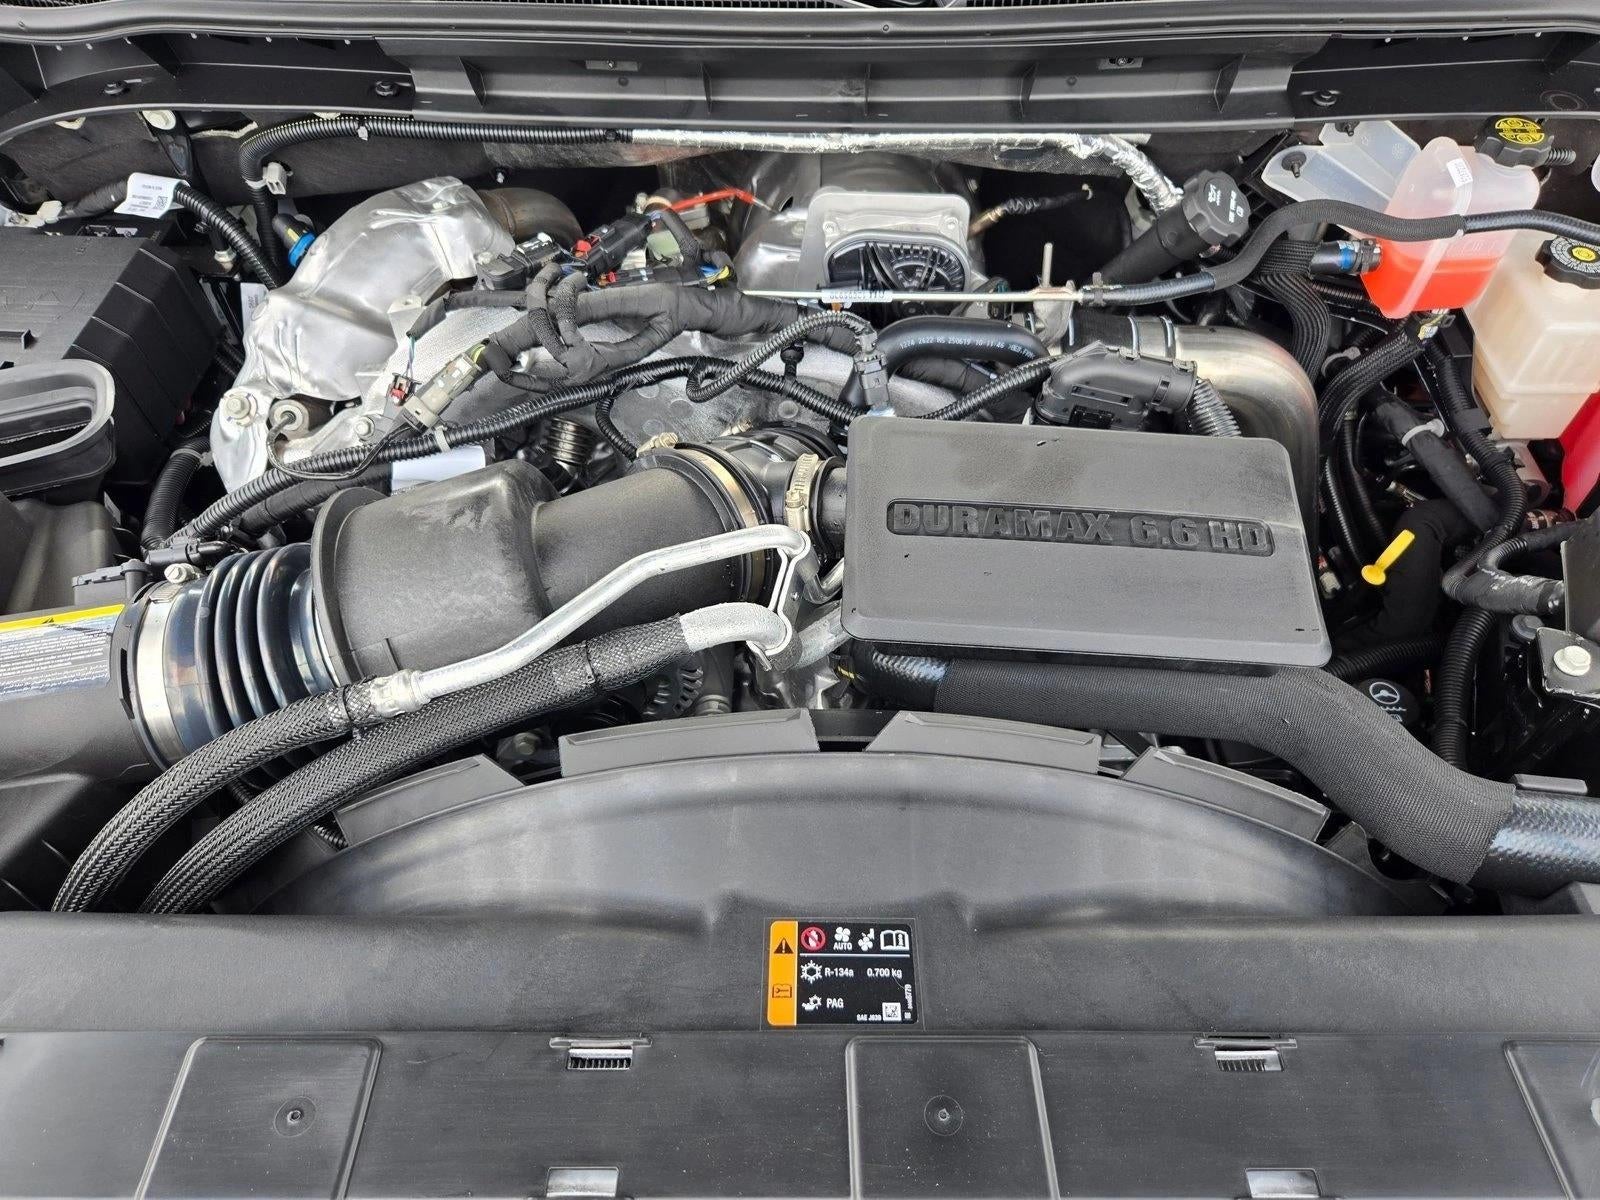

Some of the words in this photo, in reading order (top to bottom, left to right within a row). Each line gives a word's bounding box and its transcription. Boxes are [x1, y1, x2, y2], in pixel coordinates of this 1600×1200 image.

[893, 502, 1113, 542] DURAMAX
[1129, 514, 1199, 546] 6.6
[1207, 519, 1269, 552] HD
[833, 942, 852, 950] AUTO
[824, 967, 854, 977] R-134a
[866, 968, 890, 978] 0.700
[892, 968, 903, 979] kg
[826, 998, 844, 1009] PAG
